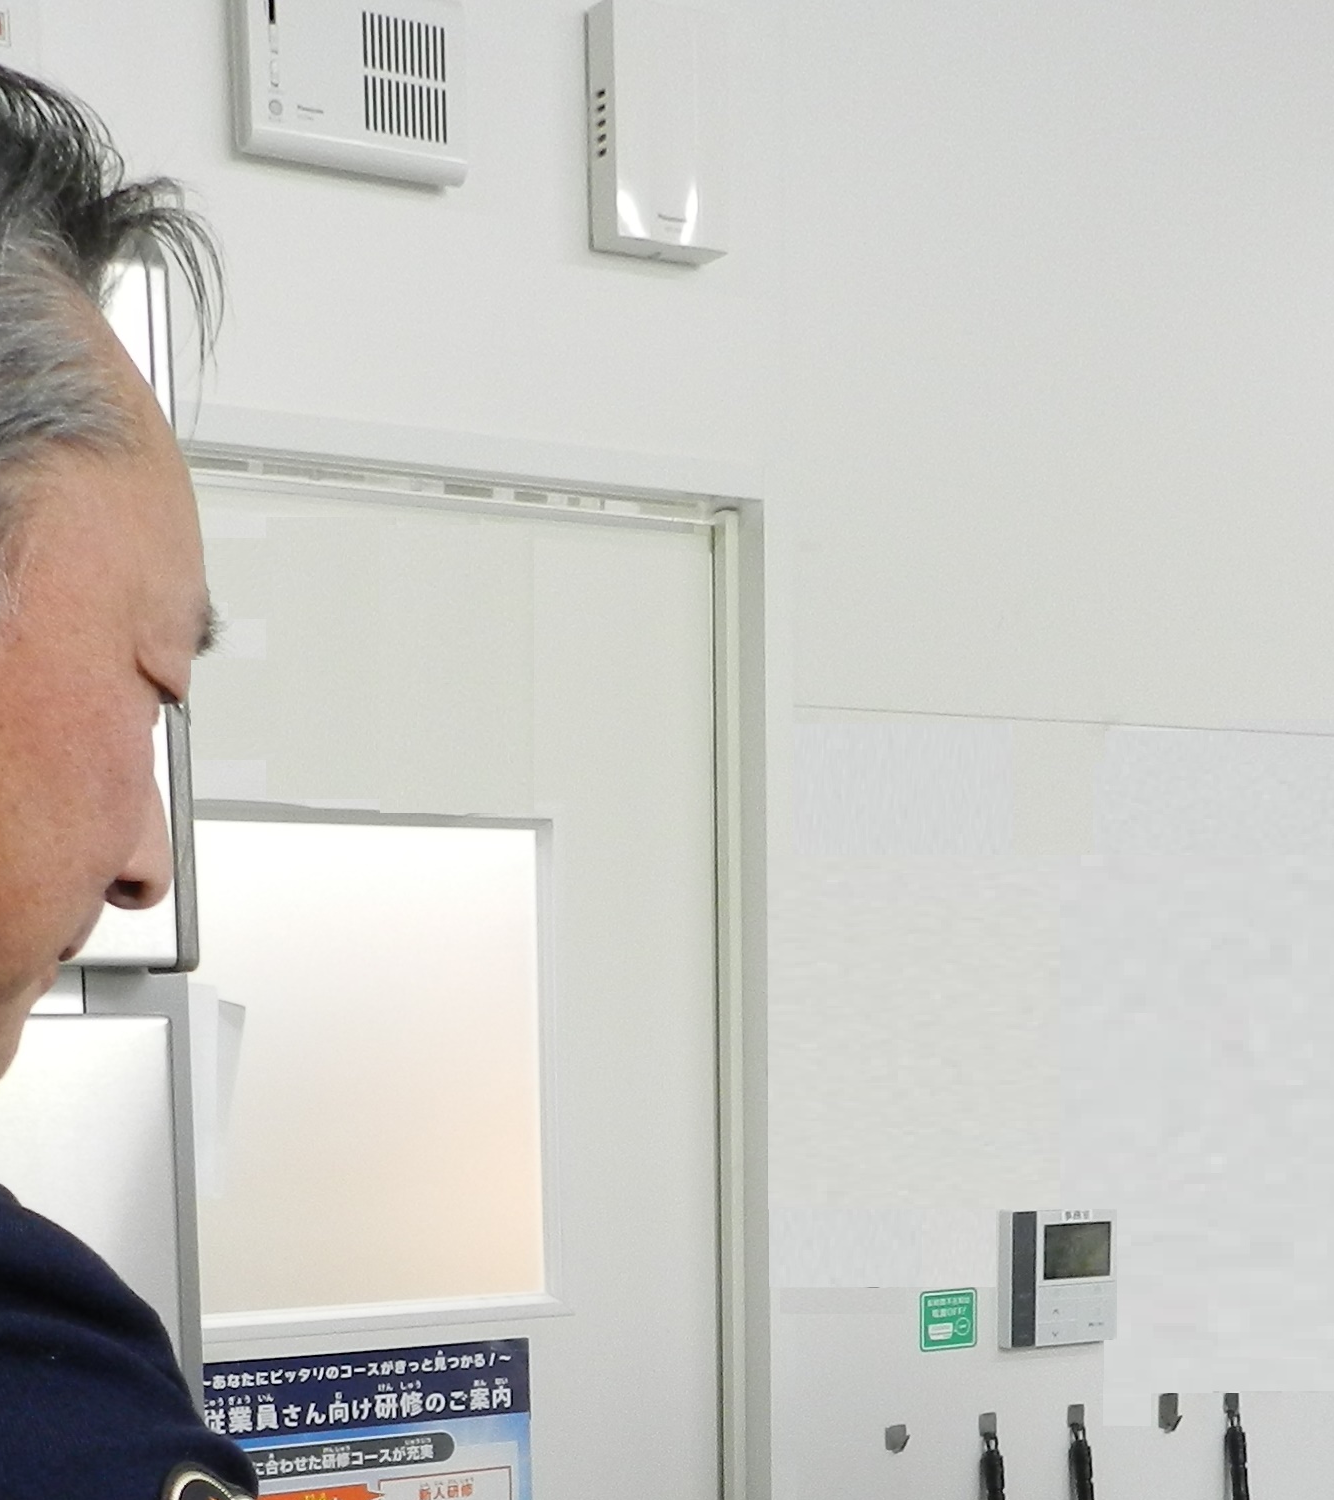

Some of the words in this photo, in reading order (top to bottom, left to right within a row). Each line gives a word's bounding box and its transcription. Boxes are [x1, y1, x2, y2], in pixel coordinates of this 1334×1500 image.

[204, 1386, 513, 1435] 従業員さん向け研修のご案内
[419, 1483, 473, 1500] 新人研修
